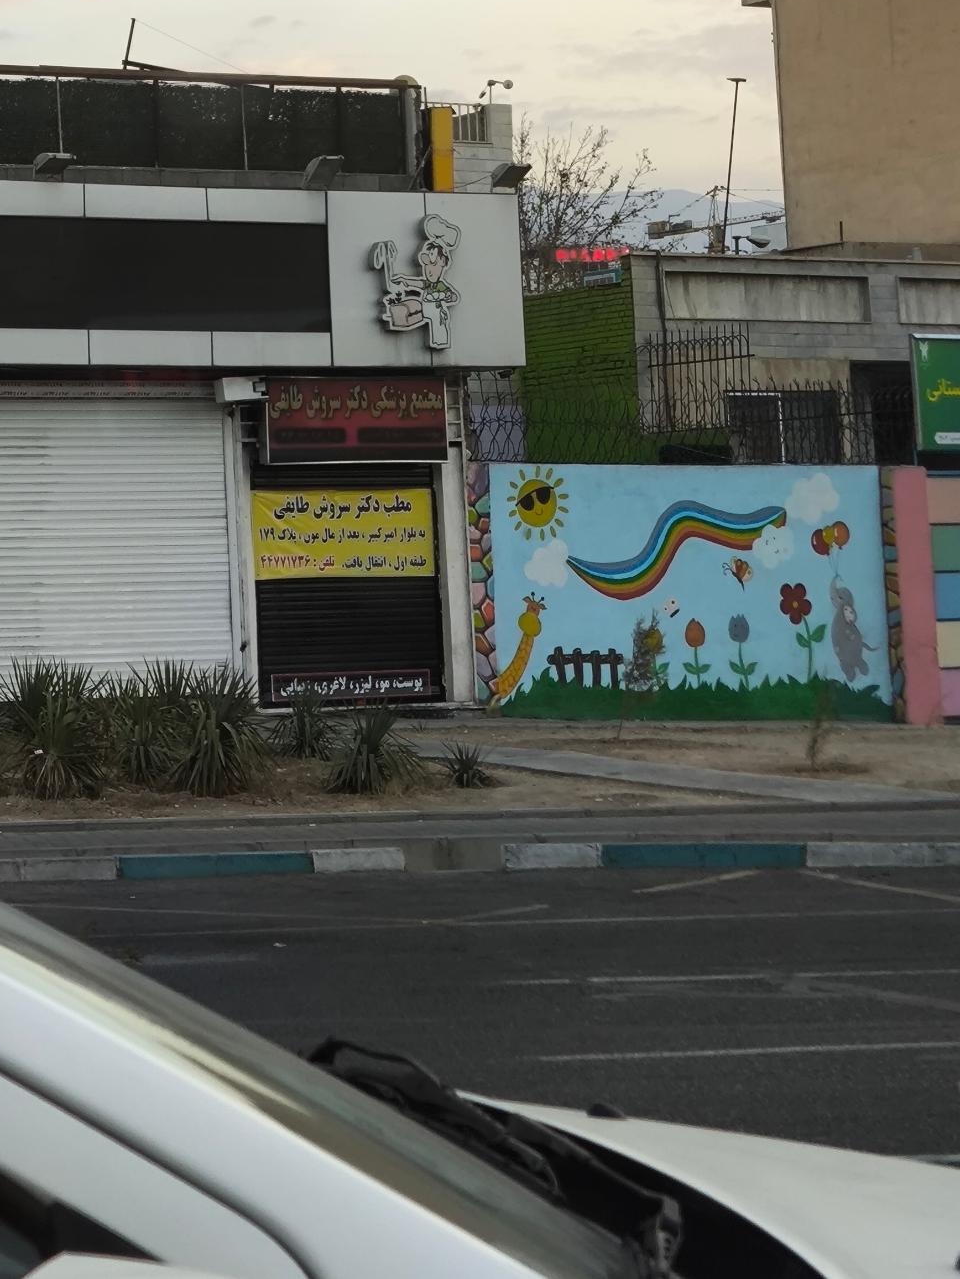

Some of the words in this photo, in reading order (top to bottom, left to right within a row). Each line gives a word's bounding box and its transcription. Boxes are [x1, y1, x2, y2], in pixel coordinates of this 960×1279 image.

[269, 384, 304, 420] طایفی
[305, 385, 342, 420] سروش
[344, 384, 368, 419] دکتر
[371, 384, 407, 419] پزشکی
[273, 495, 310, 520] طایفی
[312, 495, 351, 520] سروش
[354, 494, 380, 519] دکتر
[383, 494, 412, 517] مطب
[277, 527, 297, 543] پلاک
[338, 527, 345, 543] از
[347, 530, 360, 542] بعد
[400, 527, 416, 542] بلوار
[365, 555, 387, 572] انتقال
[393, 556, 407, 572] اول
[409, 555, 427, 571] طبقه
